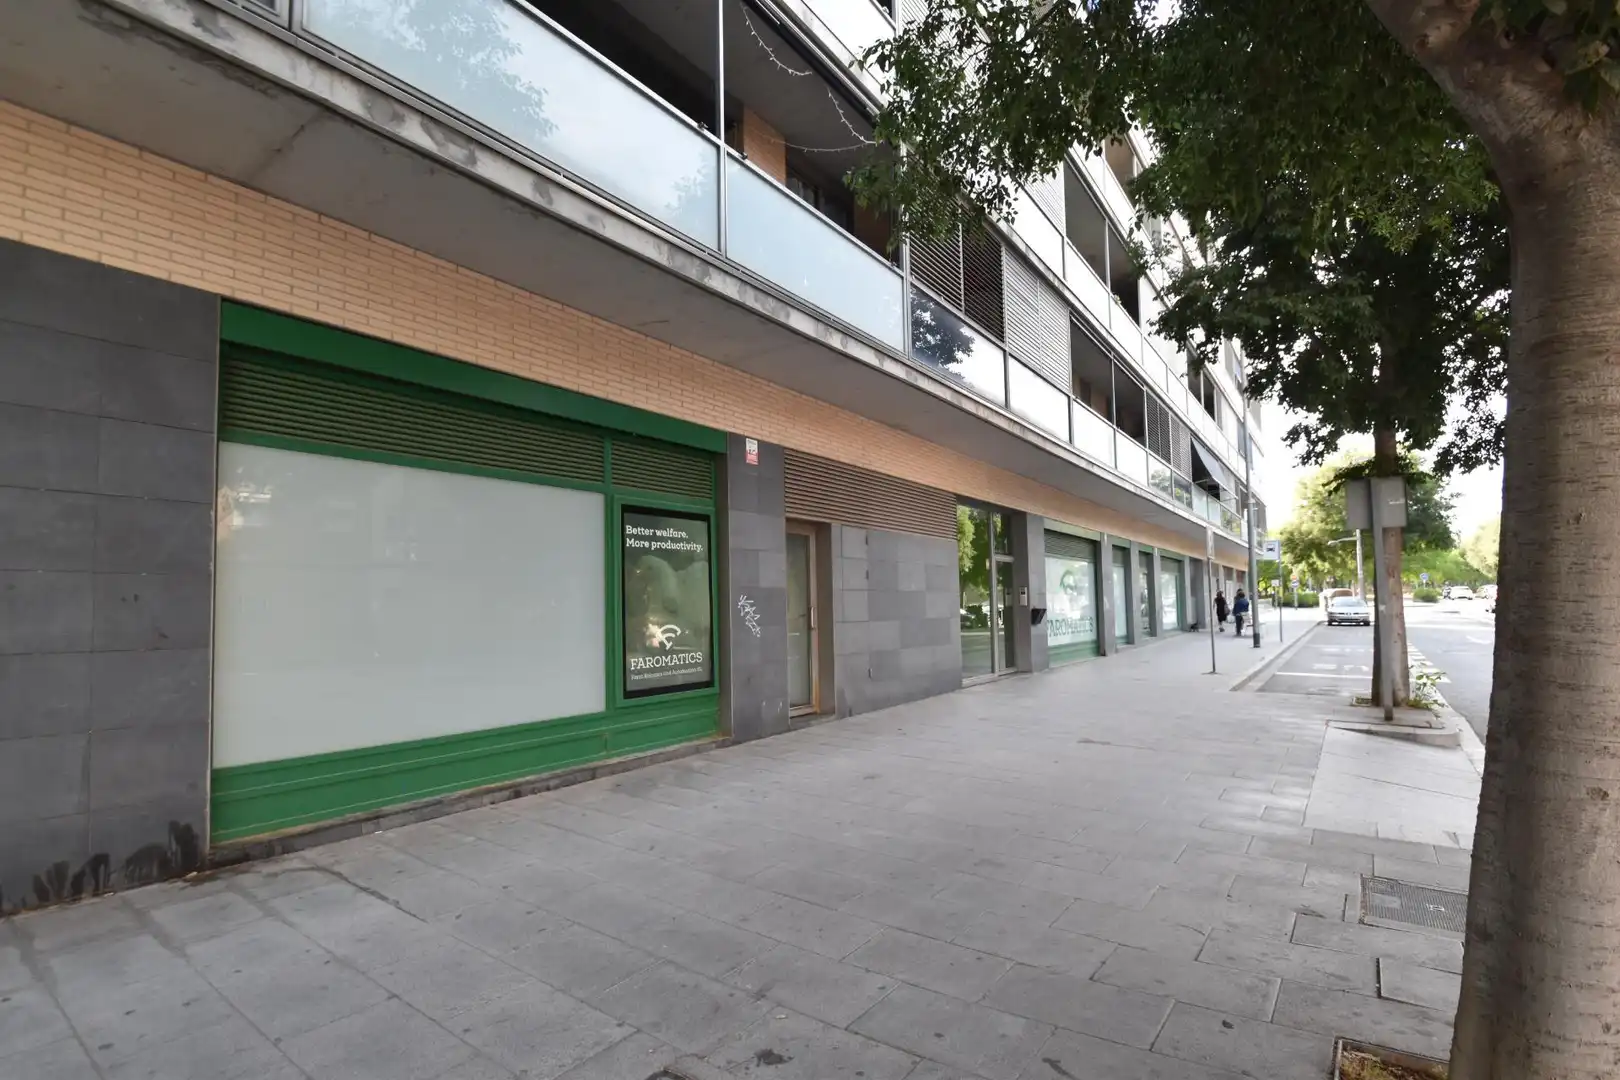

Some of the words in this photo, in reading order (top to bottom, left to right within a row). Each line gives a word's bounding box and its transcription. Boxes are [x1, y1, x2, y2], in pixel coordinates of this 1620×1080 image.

[625, 525, 655, 536] Better
[655, 528, 689, 538] welfare.
[626, 538, 650, 548] More
[651, 540, 704, 553] productivity.
[630, 652, 703, 671] FAROMATICS
